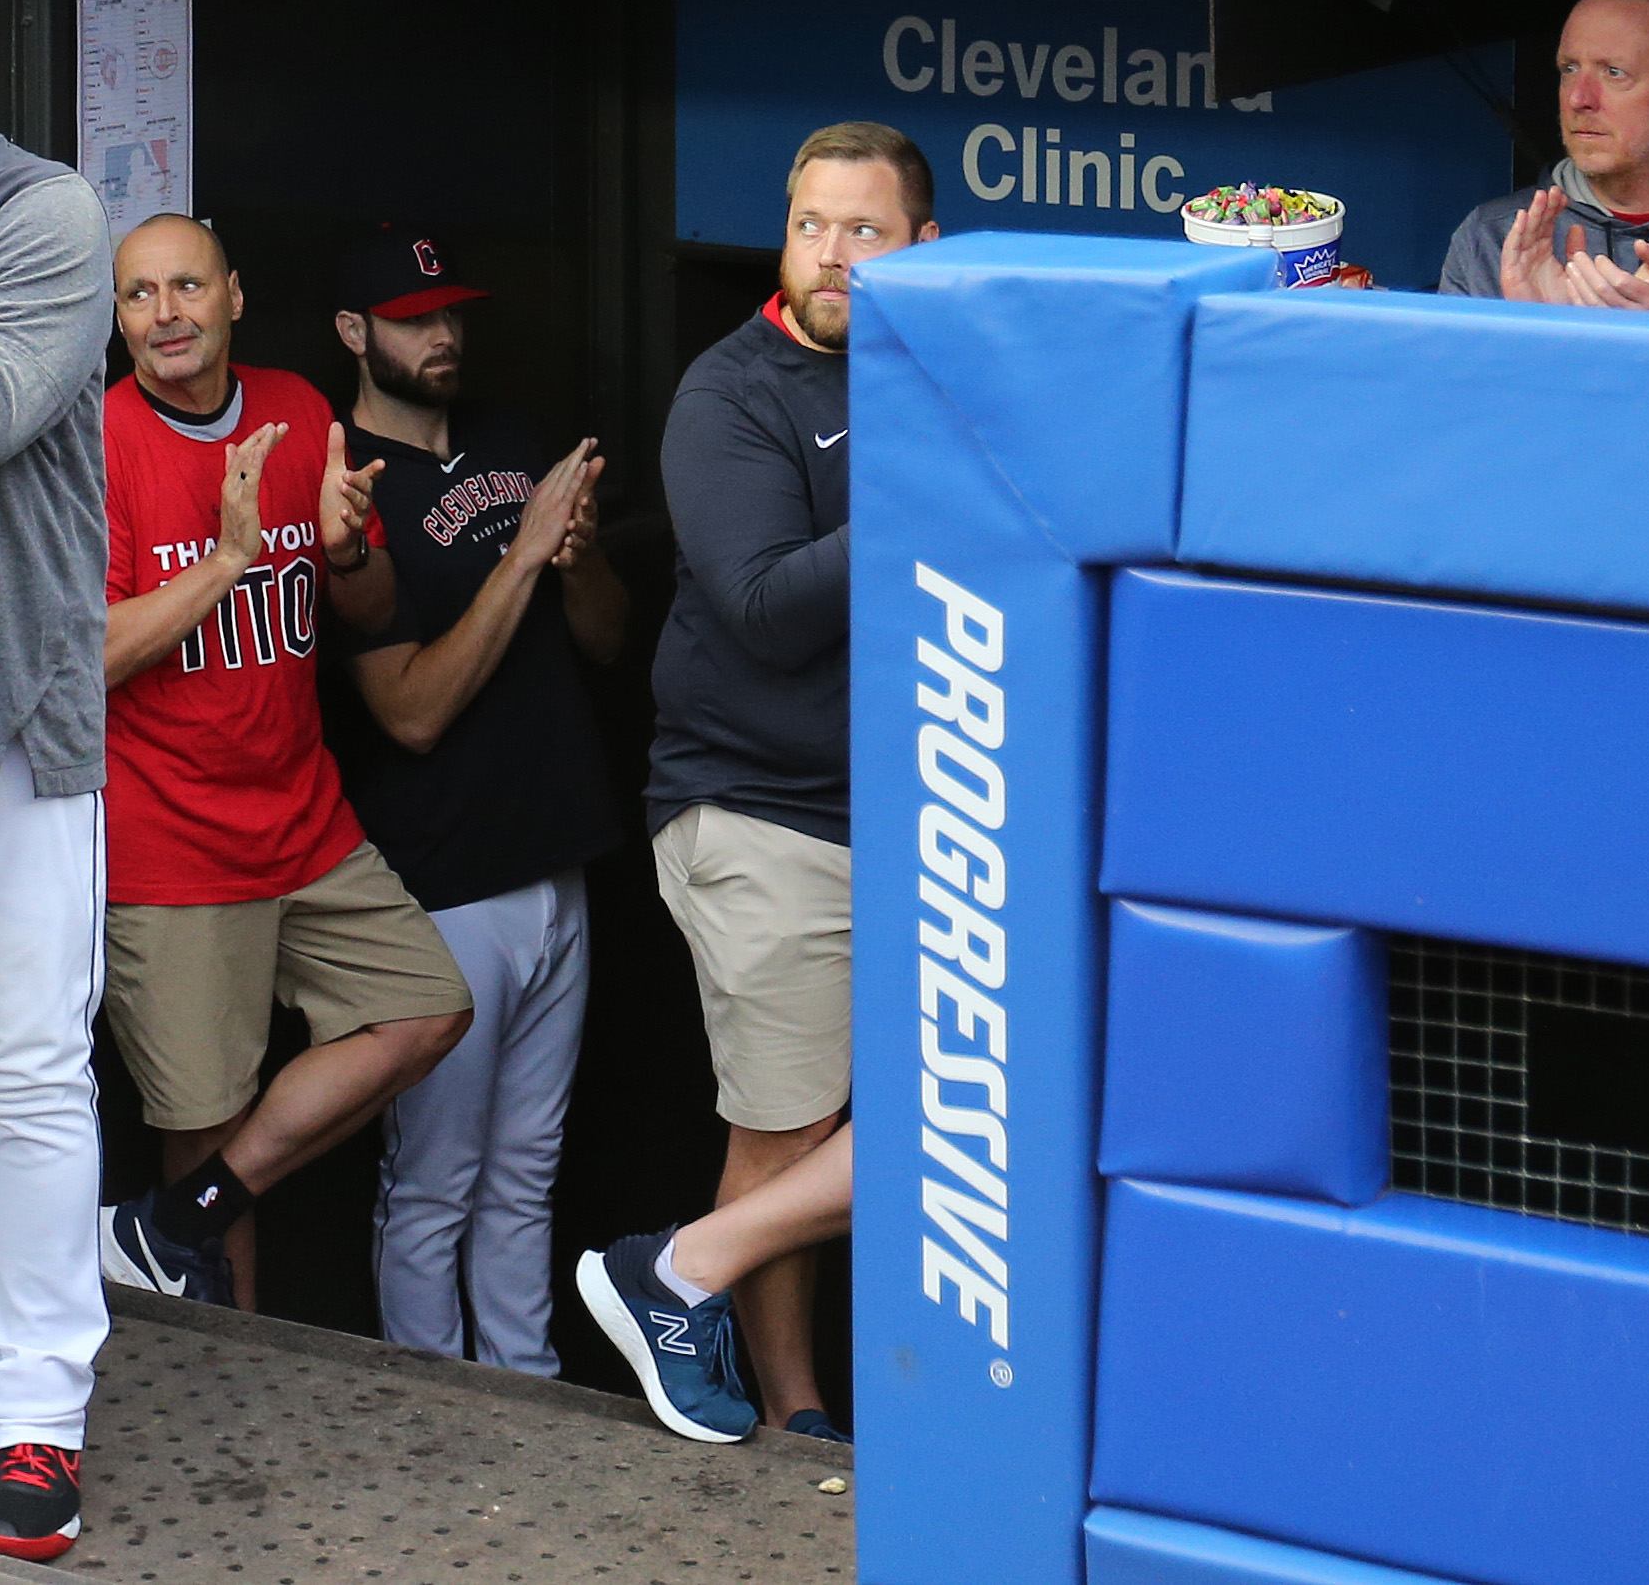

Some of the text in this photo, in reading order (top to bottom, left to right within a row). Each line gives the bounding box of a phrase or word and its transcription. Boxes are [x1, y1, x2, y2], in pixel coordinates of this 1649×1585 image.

[882, 14, 1274, 114] Clevelan
[962, 123, 1187, 214] Clinic
[413, 239, 444, 276] C
[261, 522, 315, 553] YOU
[423, 471, 535, 546] CLEVELAND
[916, 560, 1009, 1350] PROGRESSIVE
[648, 1310, 697, 1356] N
